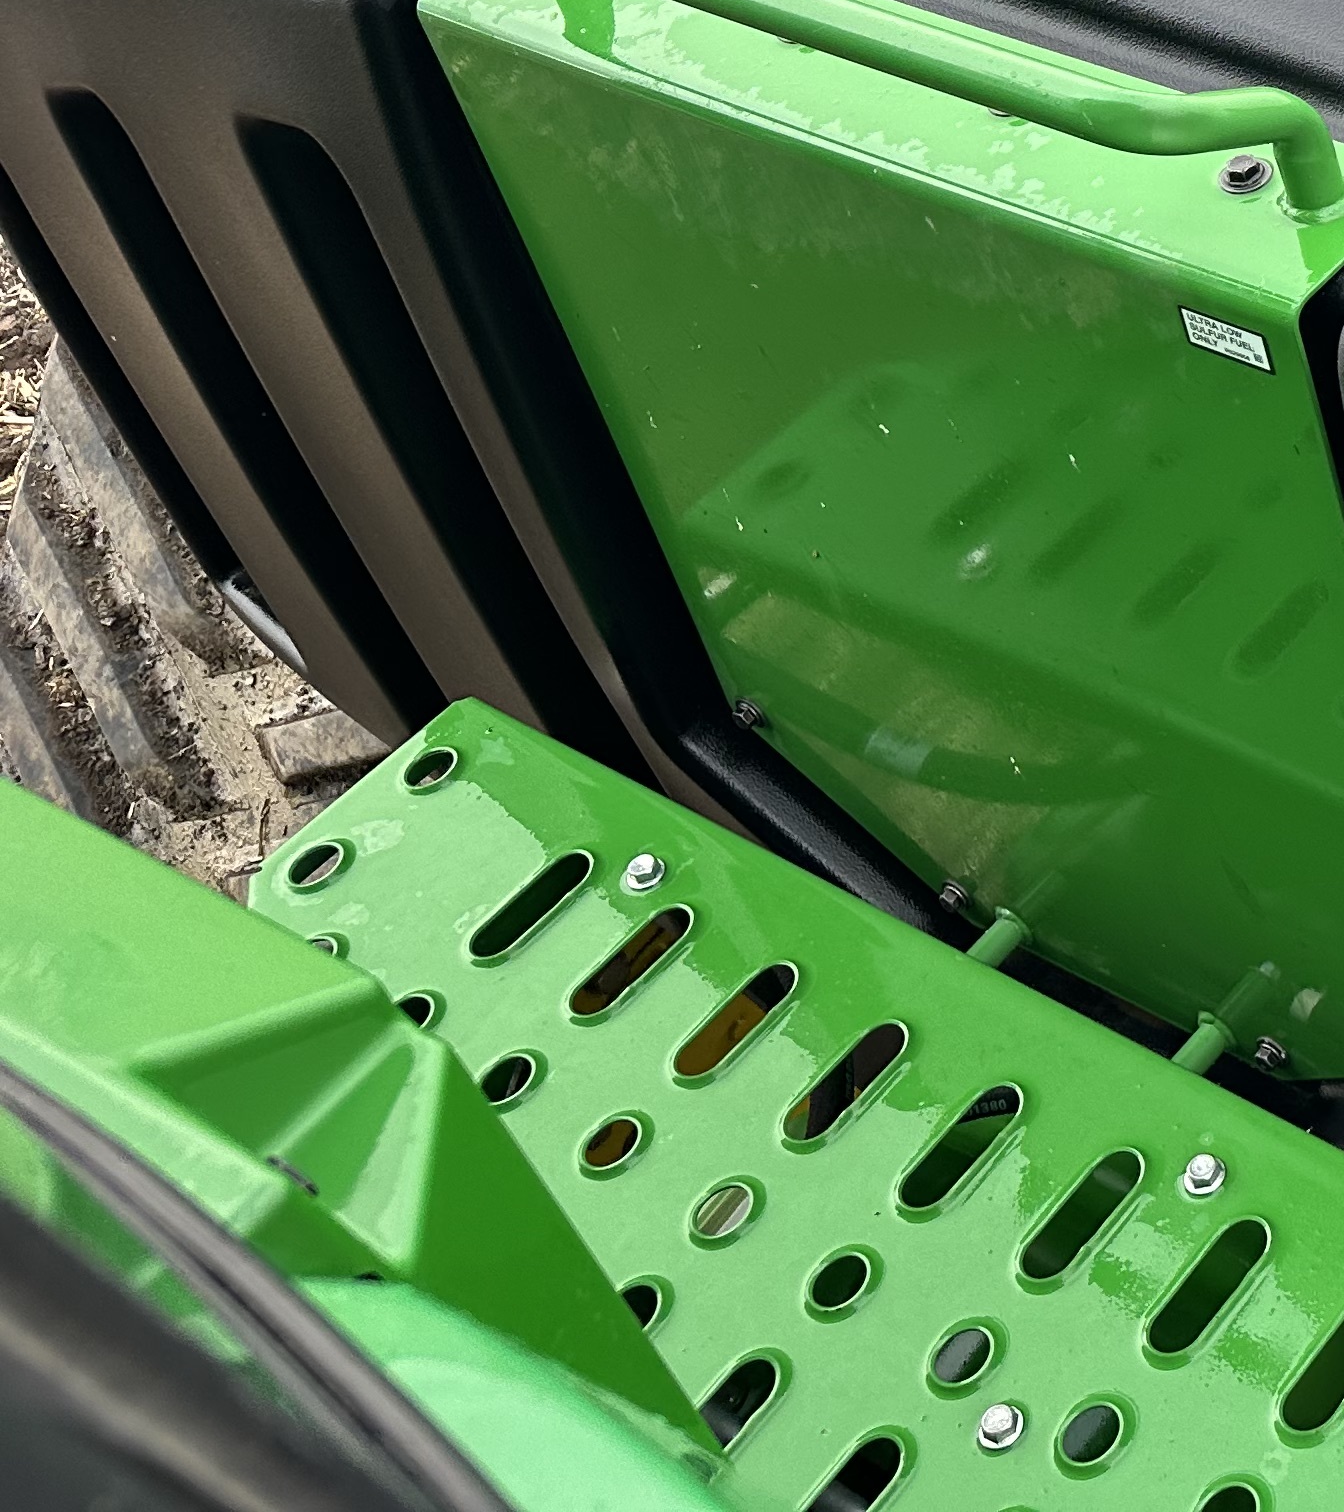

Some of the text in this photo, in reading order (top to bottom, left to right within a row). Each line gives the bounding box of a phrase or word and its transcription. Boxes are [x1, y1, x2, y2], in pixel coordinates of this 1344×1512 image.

[1186, 312, 1242, 339] ULTRA LOW
[1188, 322, 1228, 343] SULFUR
[1192, 332, 1218, 347] ONLY
